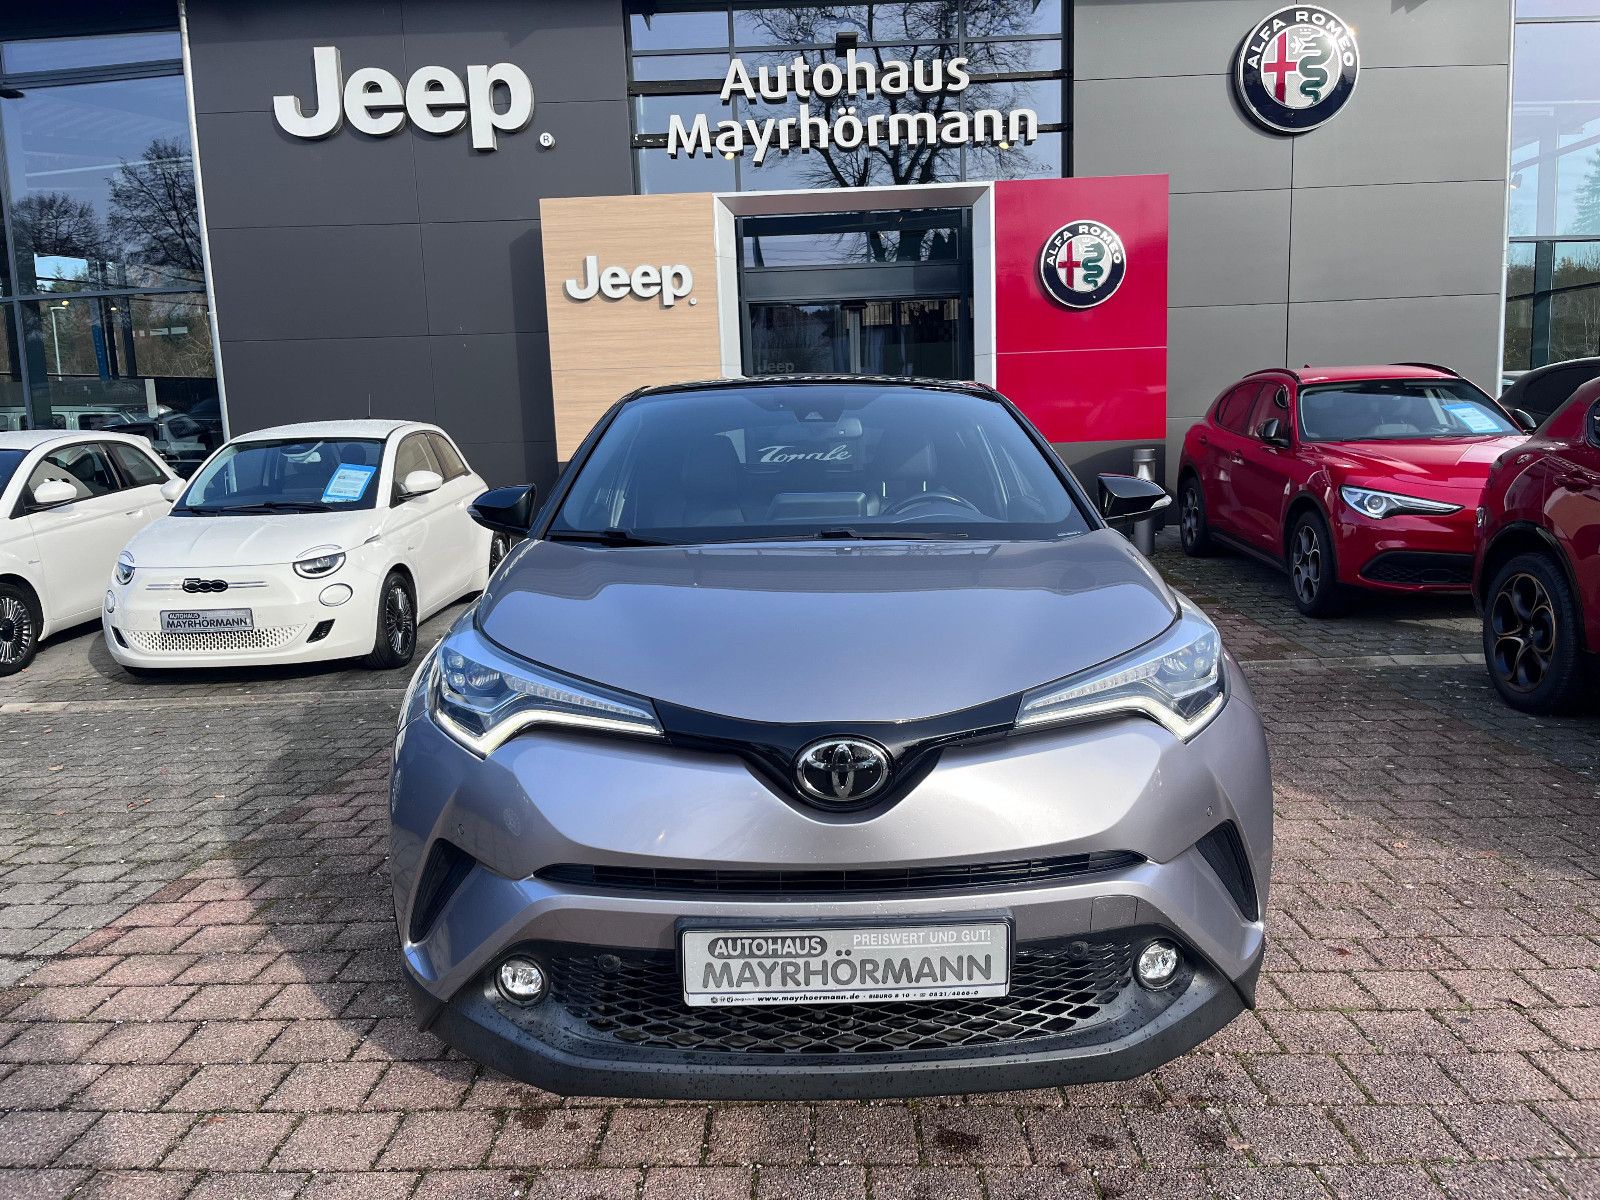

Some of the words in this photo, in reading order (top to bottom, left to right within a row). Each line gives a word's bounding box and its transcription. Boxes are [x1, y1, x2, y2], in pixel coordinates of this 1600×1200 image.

[1247, 18, 1287, 70] ALFA
[1295, 10, 1355, 67] ROMEO
[720, 48, 970, 104] Autohaus
[273, 46, 534, 150] Jeep
[666, 102, 1039, 166] Mayrhörmann
[1046, 230, 1073, 266] ALFA
[1078, 225, 1122, 264] ROMEO
[565, 255, 693, 307] Jeep
[182, 578, 228, 593] 500
[166, 616, 248, 628] MAYRHÖRMANN
[714, 937, 822, 956] AUTOHAUS
[853, 932, 926, 946] PREISWERT
[929, 931, 957, 943] UND
[961, 929, 992, 941] GUT!
[702, 949, 992, 989] MAYRHÖRMANN
[757, 993, 860, 1003] www.mayrhoermann.de
